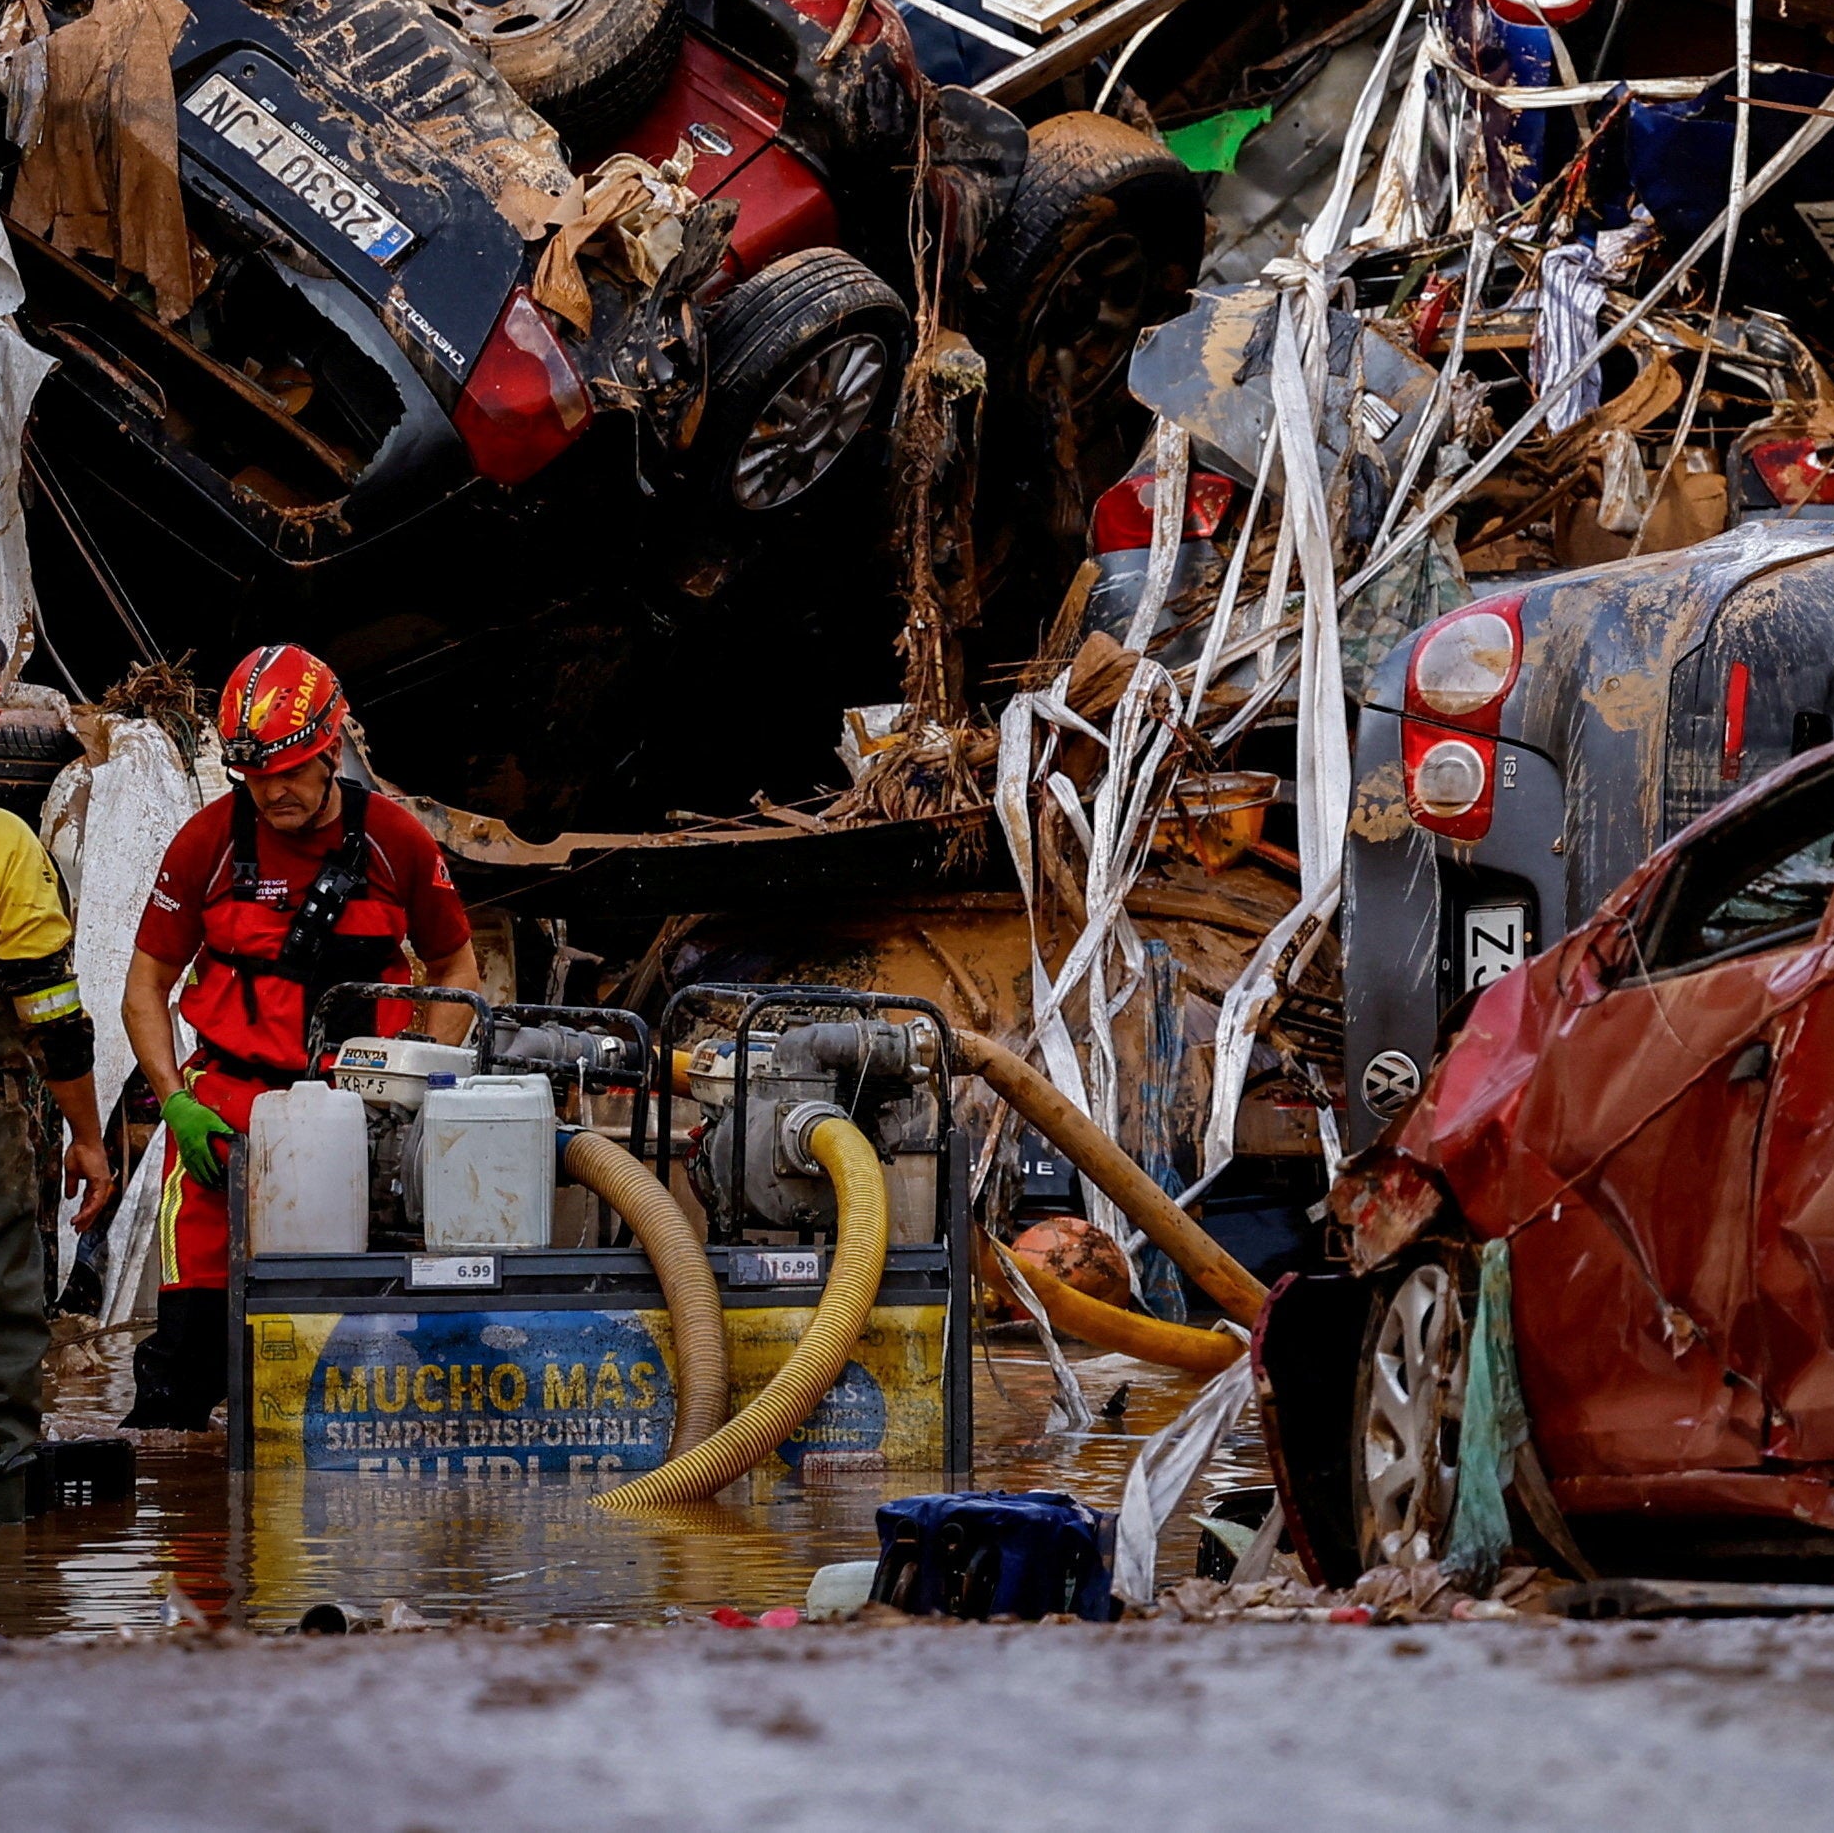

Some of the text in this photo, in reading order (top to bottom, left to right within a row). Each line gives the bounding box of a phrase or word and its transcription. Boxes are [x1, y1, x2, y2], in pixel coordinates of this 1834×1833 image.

[199, 90, 284, 162] FJN
[289, 120, 330, 158] MOTORS
[691, 123, 729, 151] NISSAN
[277, 154, 383, 242] 2630
[1503, 756, 1517, 789] FSI
[343, 1049, 389, 1061] HONDA
[457, 1265, 492, 1278] 6.99
[781, 1260, 816, 1274] 6.99
[324, 1351, 656, 1413] MUCHO MÁS
[326, 1417, 653, 1450] SIEMPRE DISPONIBLE
